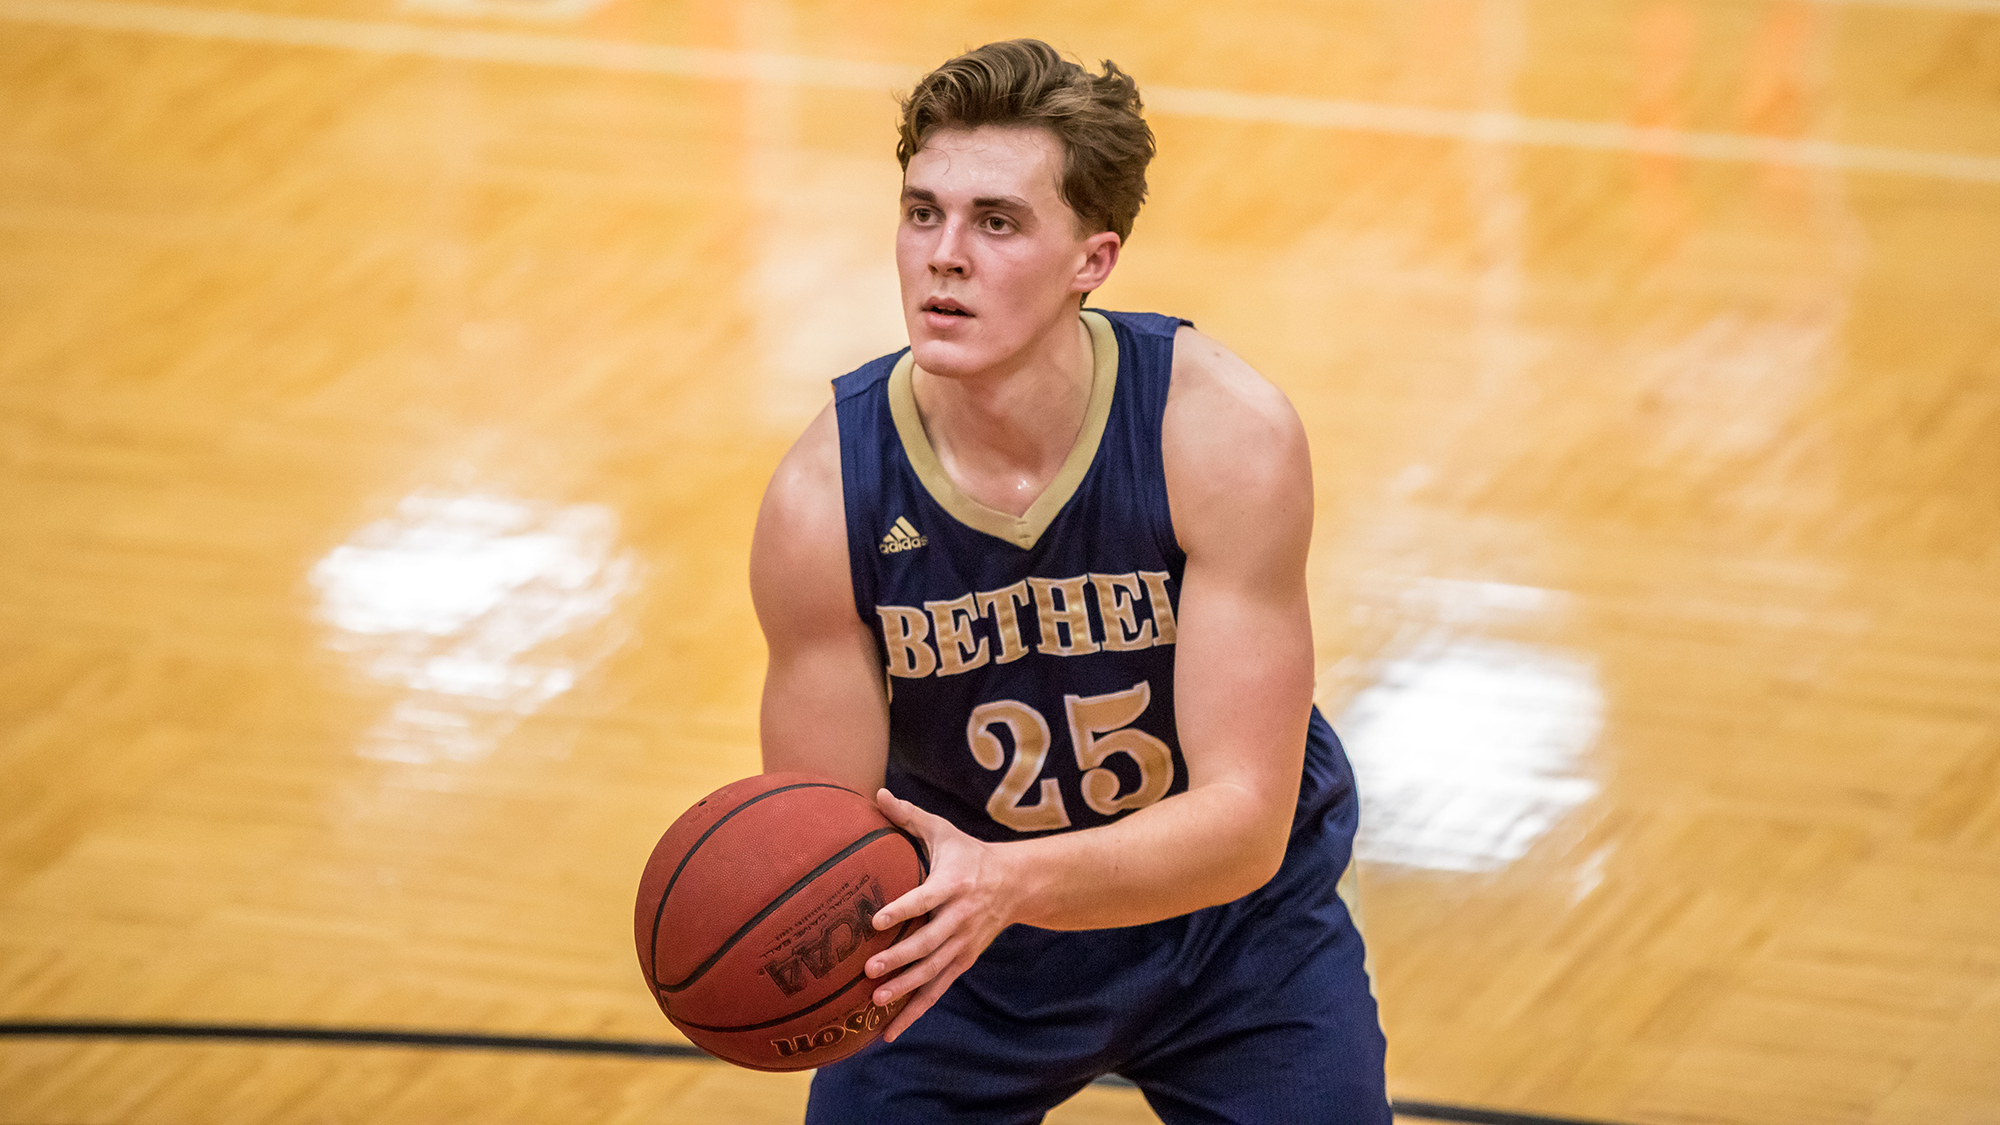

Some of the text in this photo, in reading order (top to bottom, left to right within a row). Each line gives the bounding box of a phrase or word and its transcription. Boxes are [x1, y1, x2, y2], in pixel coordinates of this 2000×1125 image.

[879, 535, 928, 554] adidas
[966, 680, 1174, 832] 25
[759, 874, 870, 959] OFFICIAL GAME BALL
[763, 878, 886, 998] NCAA
[770, 998, 902, 1057] lson
